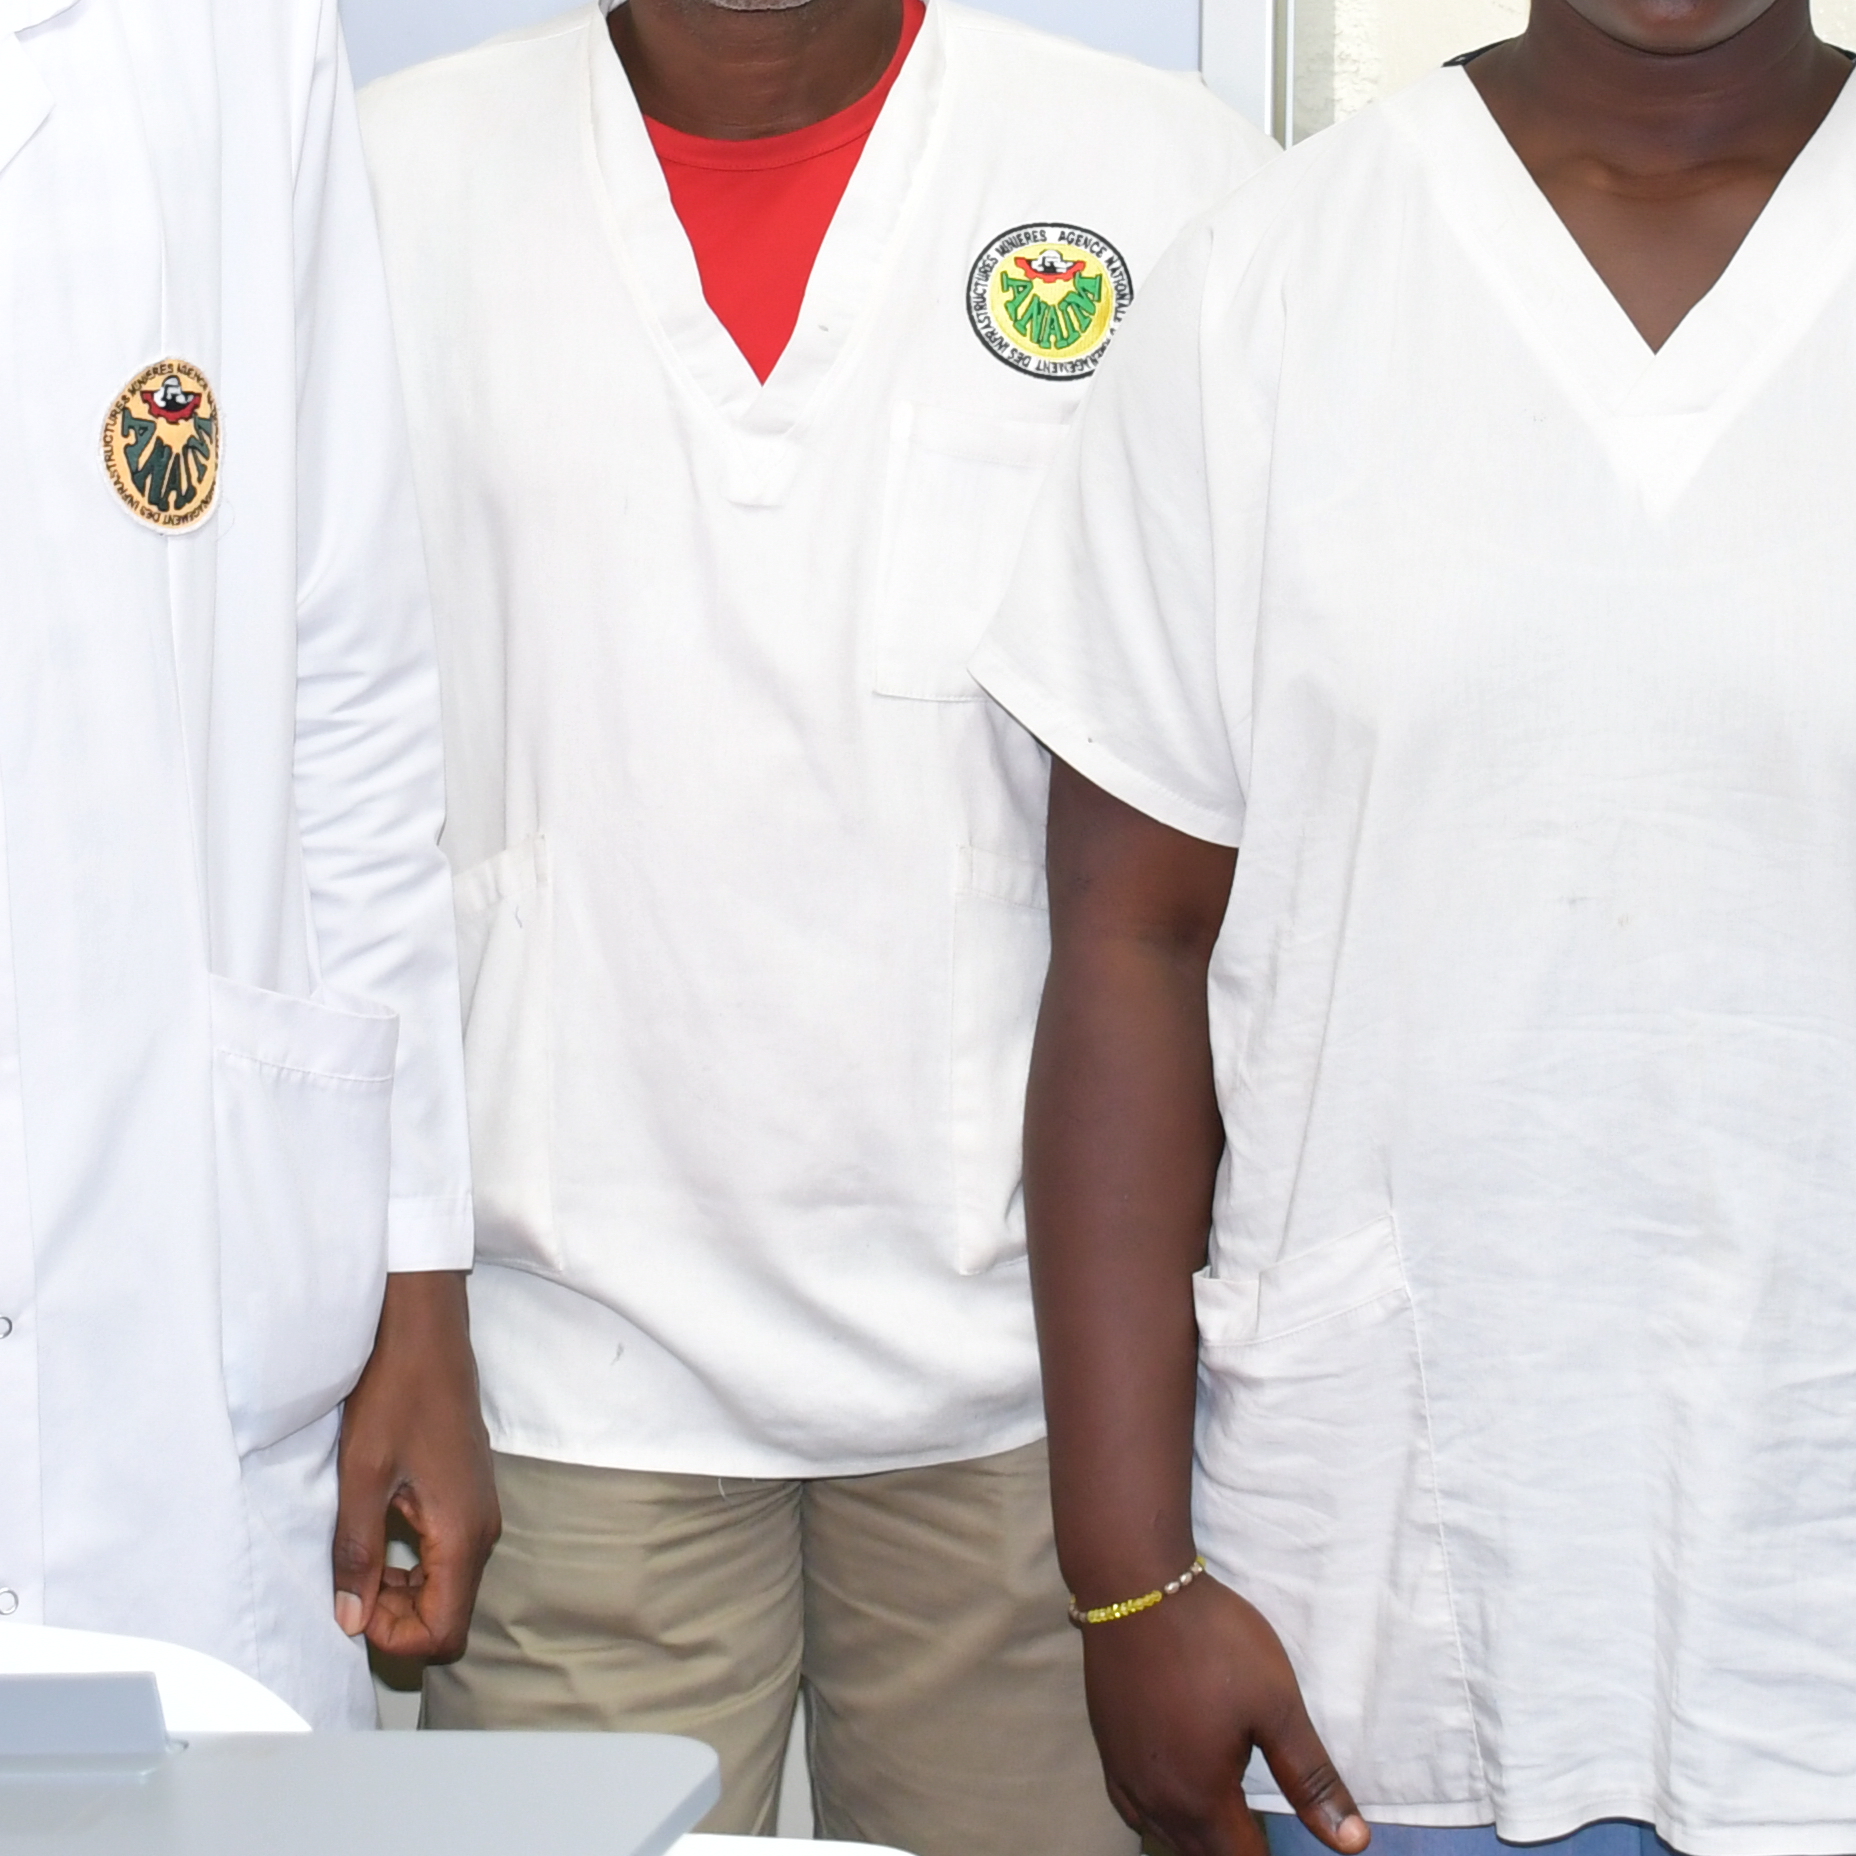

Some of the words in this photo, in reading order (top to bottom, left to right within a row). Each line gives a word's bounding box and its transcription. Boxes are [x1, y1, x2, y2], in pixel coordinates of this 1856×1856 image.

[1058, 230, 1108, 259] AGENCE
[973, 254, 1008, 354] INFRASTRUCTURES
[1000, 270, 1102, 350] ANAIM
[1007, 347, 1031, 369] DES
[122, 406, 213, 512] ANAIM
